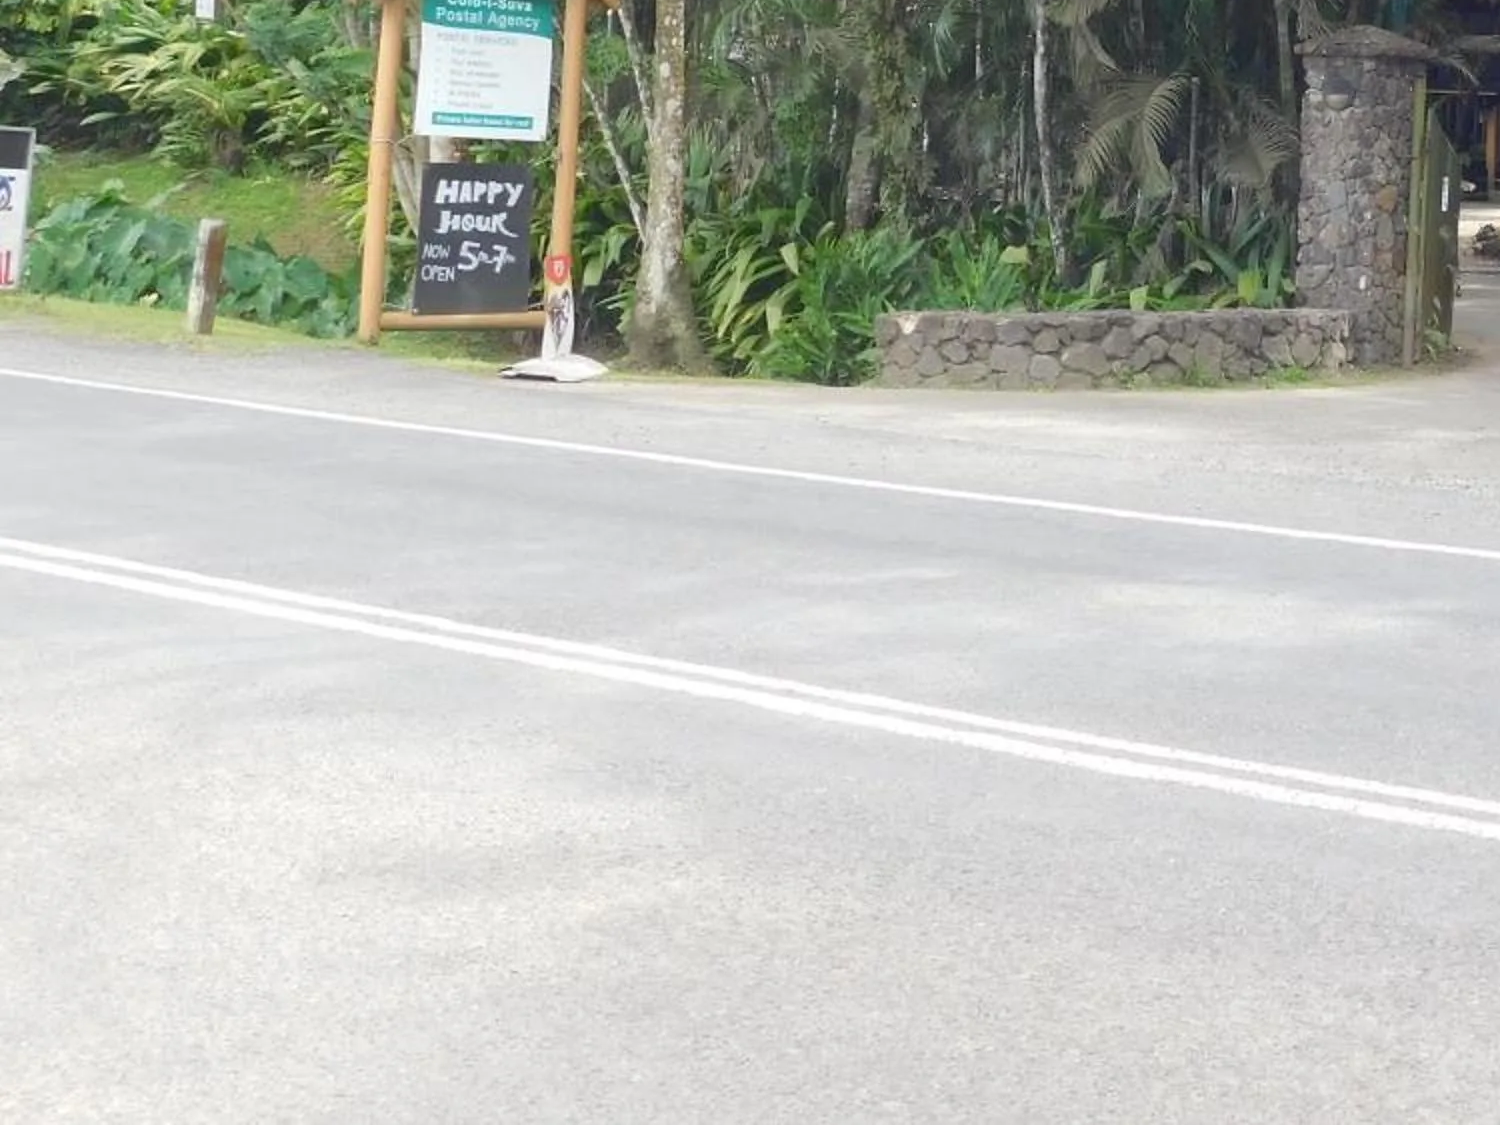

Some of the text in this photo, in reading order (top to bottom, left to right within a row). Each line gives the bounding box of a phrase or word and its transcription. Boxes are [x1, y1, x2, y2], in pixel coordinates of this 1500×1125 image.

[436, 6, 540, 32] Postal Agency
[434, 179, 524, 207] HAPPY
[432, 210, 520, 238] HOUR
[421, 242, 451, 260] NOW
[421, 263, 455, 282] OPEN
